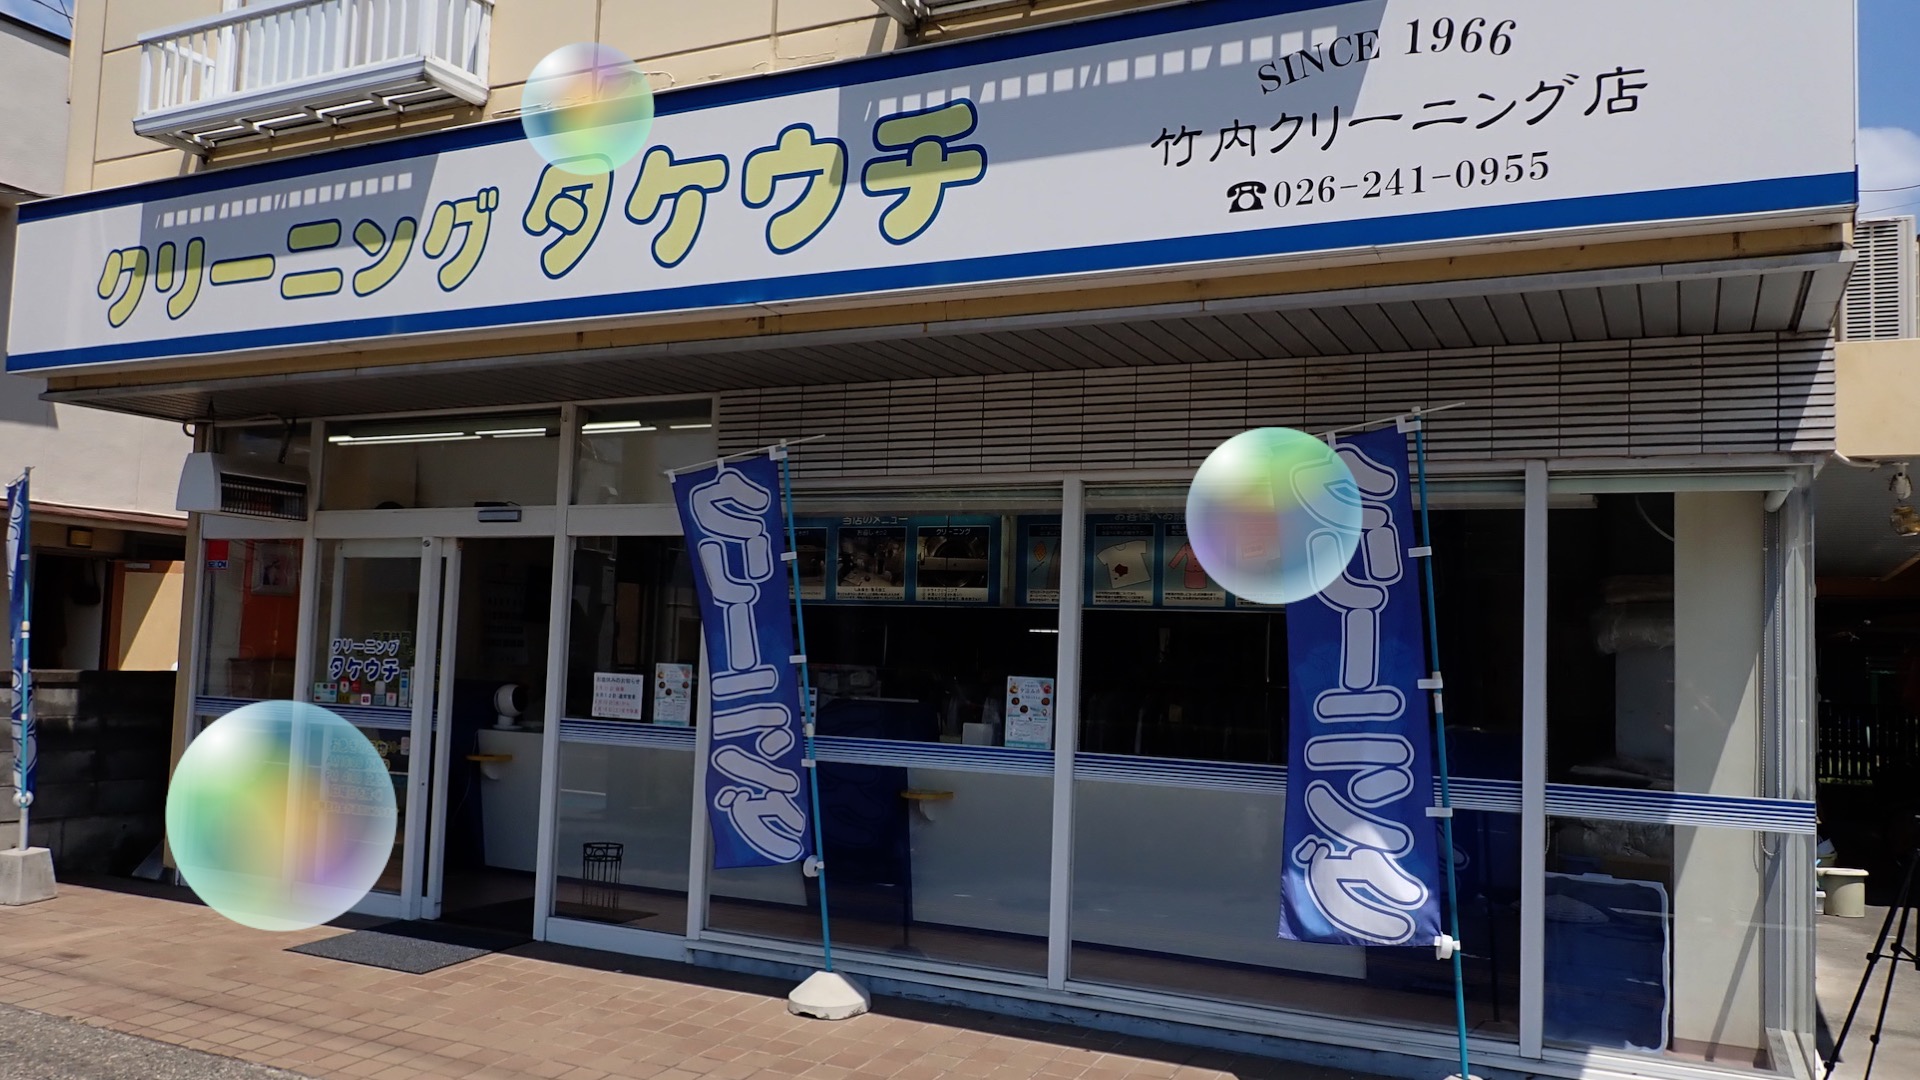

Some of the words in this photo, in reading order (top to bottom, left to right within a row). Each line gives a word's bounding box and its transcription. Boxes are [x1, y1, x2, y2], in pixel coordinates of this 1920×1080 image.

[1256, 28, 1381, 96] SINCE
[1403, 16, 1517, 56] 1966
[1150, 65, 1649, 168] 竹内クリーニング店
[97, 185, 500, 329] クリーニング
[522, 97, 988, 280] タケウチ
[1273, 150, 1551, 208] 026-241-0955
[329, 656, 400, 683] タケウチ
[332, 638, 400, 656] クリーニング
